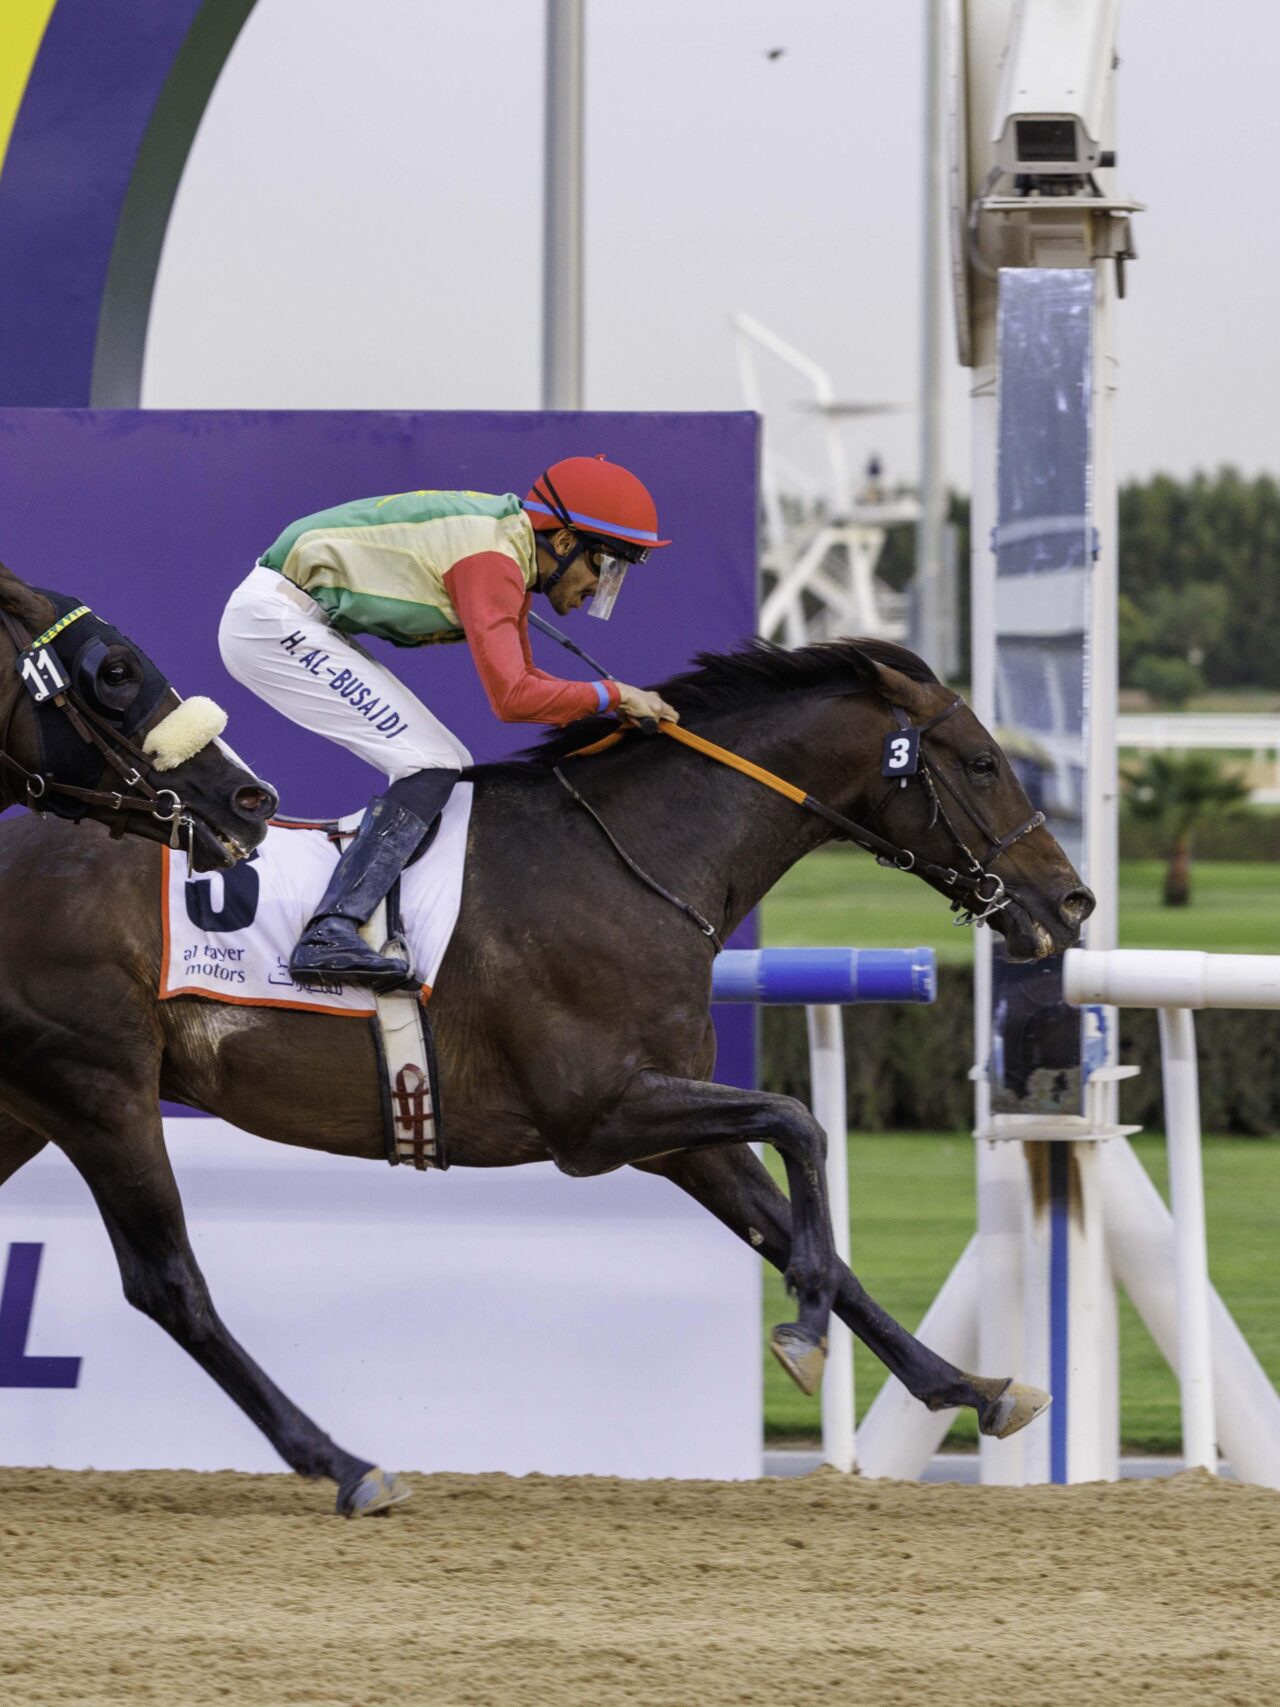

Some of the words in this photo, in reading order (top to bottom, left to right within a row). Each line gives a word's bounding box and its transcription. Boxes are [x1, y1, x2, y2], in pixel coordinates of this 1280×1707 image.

[21, 648, 65, 698] 11
[299, 650, 409, 739] AL-BUSAIDI
[888, 737, 911, 769] 3
[183, 945, 199, 961] al
[203, 945, 245, 962] tayer
[185, 962, 246, 984] motors
